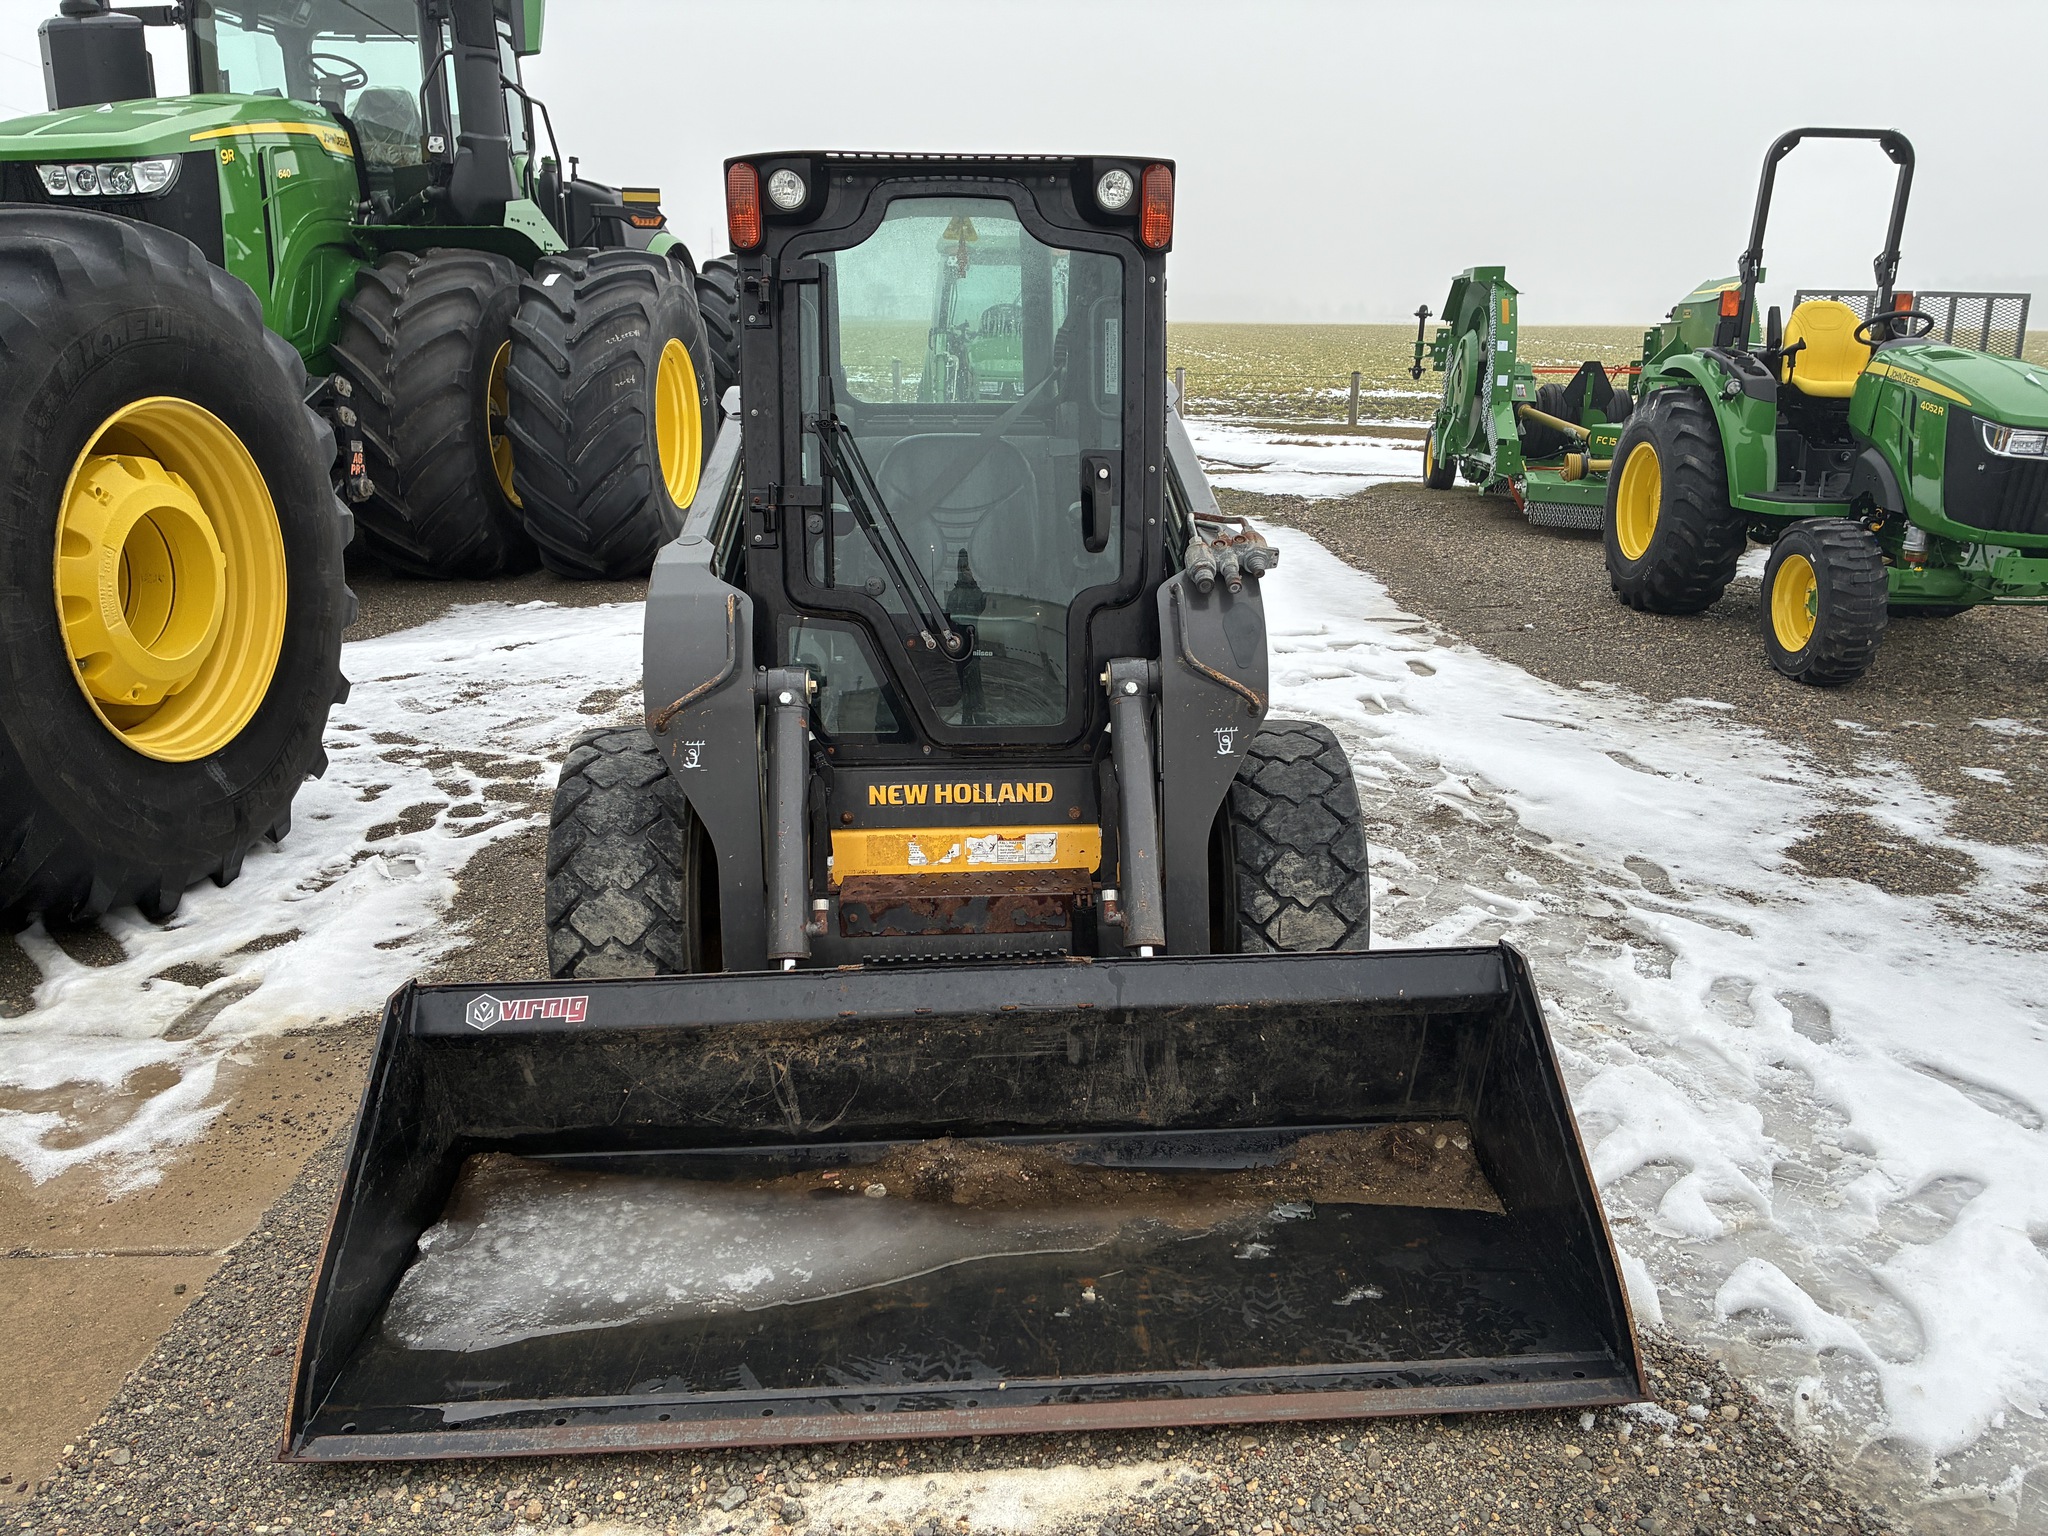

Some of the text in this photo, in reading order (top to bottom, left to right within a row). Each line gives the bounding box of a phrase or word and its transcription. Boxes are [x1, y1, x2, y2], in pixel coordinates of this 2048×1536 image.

[220, 149, 235, 165] 9R
[277, 168, 292, 178] 640
[1890, 370, 1919, 386] JOHN DEERE
[1596, 436, 1608, 445] FC
[353, 452, 363, 464] AG
[868, 782, 1054, 805] NEW HOLLAND
[501, 995, 589, 1023] virnig
